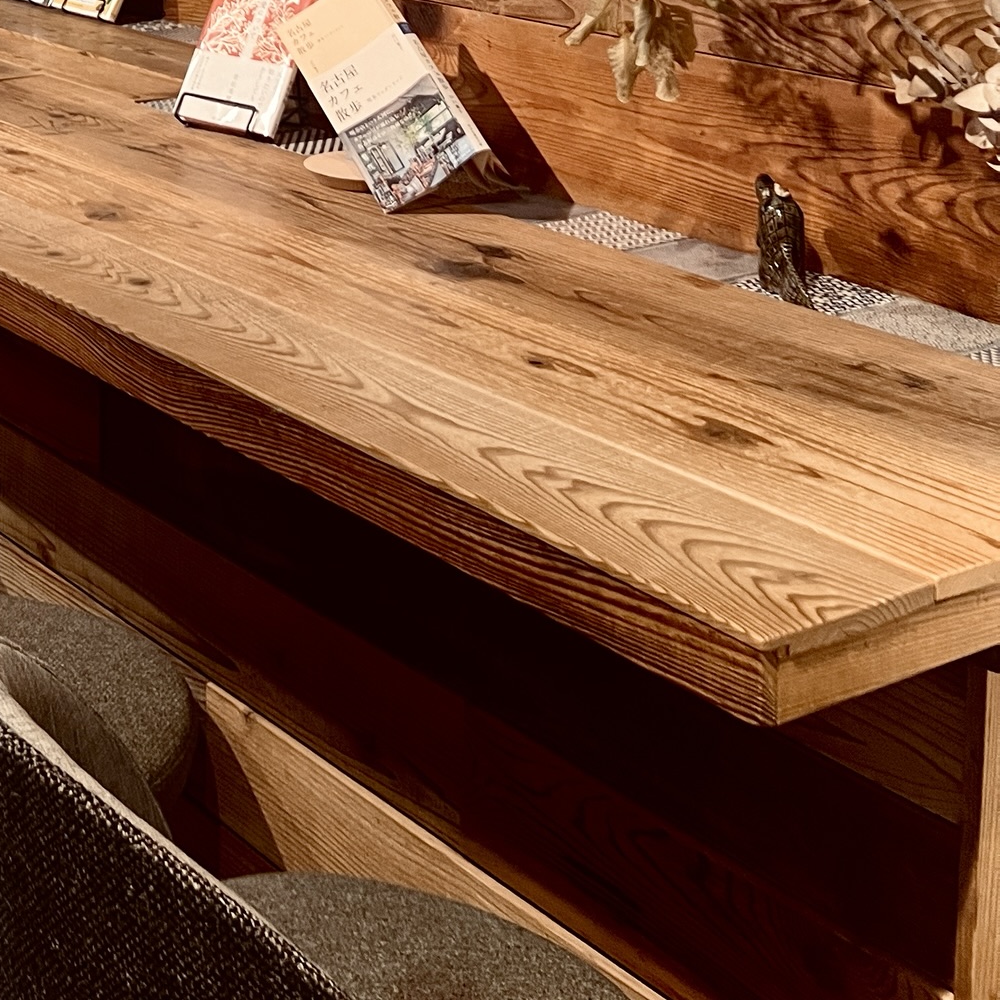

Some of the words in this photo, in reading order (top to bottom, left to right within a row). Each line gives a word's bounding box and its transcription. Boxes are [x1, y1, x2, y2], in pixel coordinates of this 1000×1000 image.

[320, 63, 359, 94] 名古屋
[328, 85, 363, 108] カフェ
[335, 100, 363, 123] 散歩
